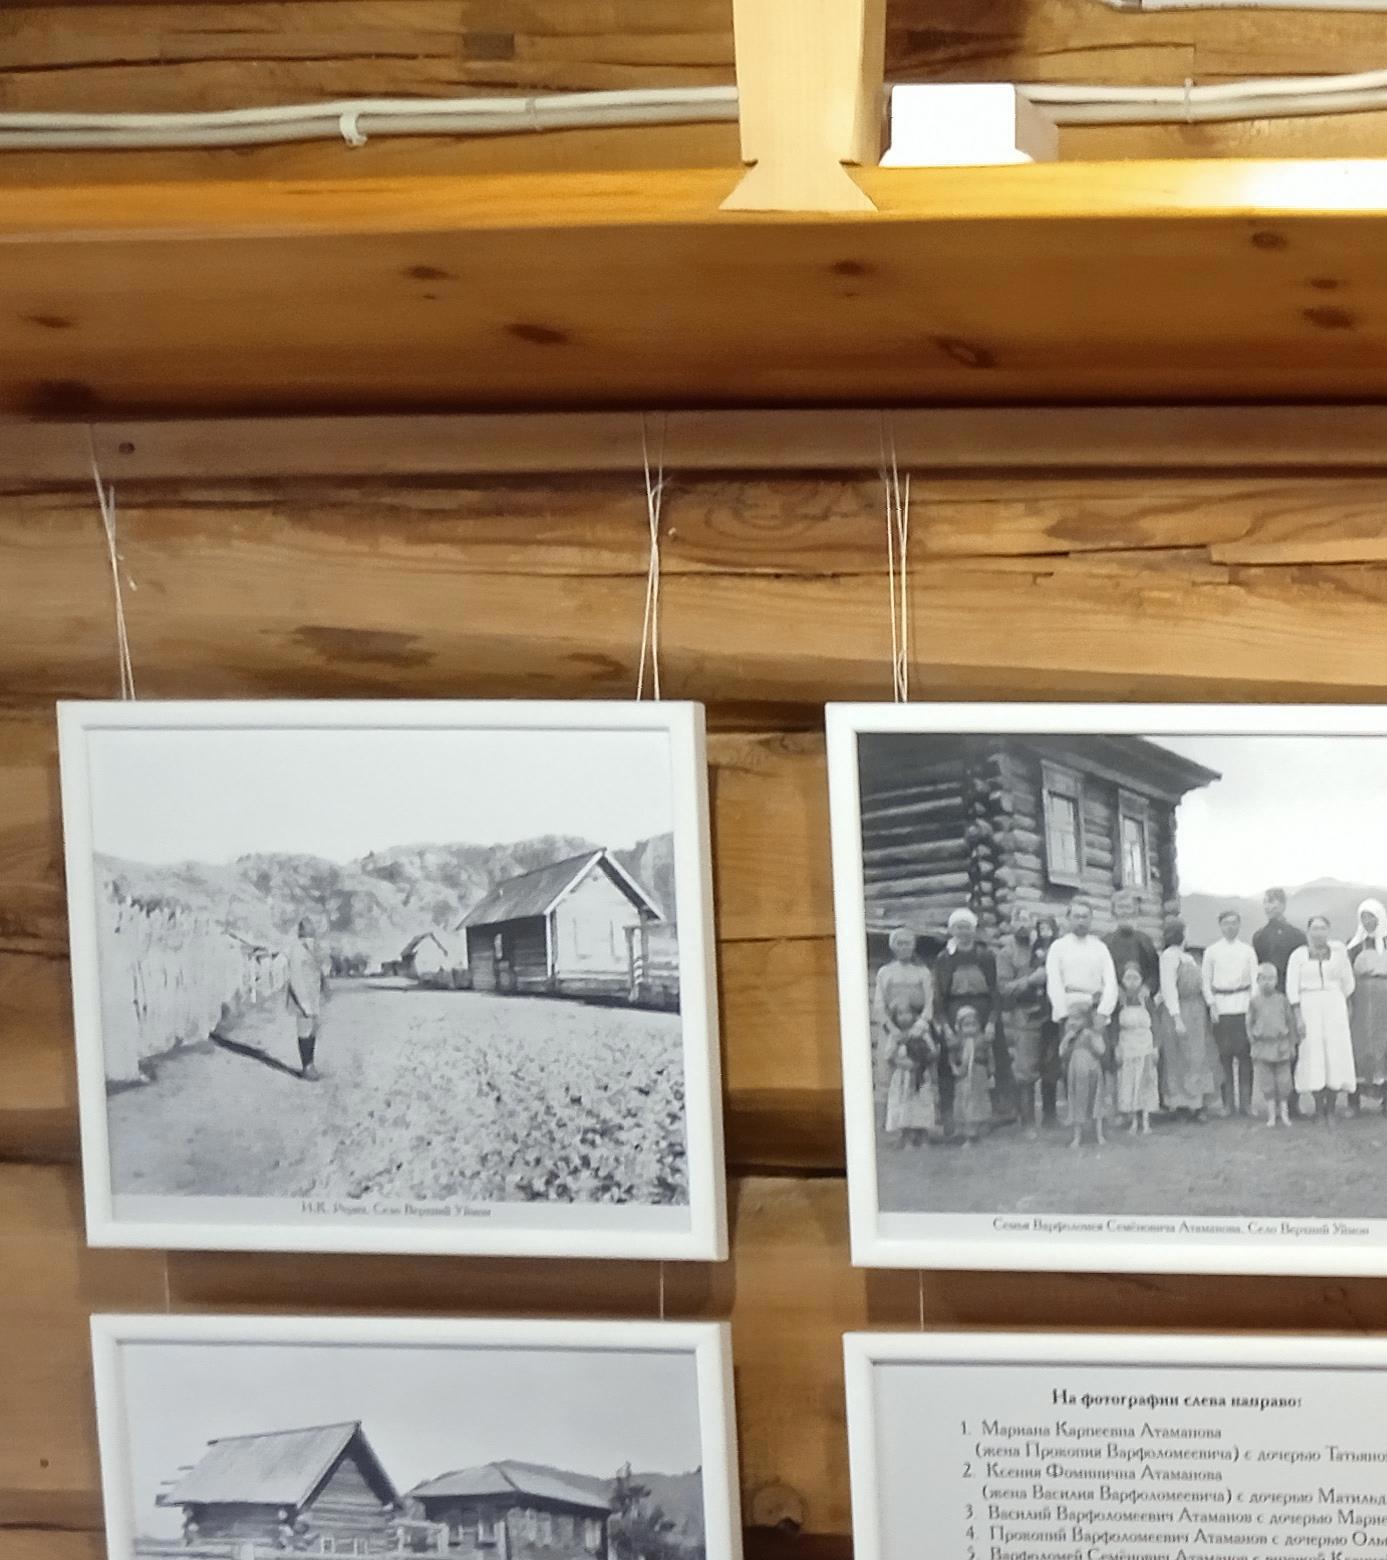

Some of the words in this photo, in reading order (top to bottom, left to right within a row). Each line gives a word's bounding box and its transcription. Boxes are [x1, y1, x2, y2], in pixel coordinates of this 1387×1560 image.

[1052, 1389, 1076, 1406] На
[1080, 1390, 1179, 1410] фотографии
[1183, 1395, 1226, 1407] слева
[1230, 1396, 1301, 1411] направо:
[1243, 1449, 1250, 1461] с
[1235, 1491, 1243, 1503] с
[1256, 1513, 1262, 1524] с
[1271, 1533, 1278, 1545] с
